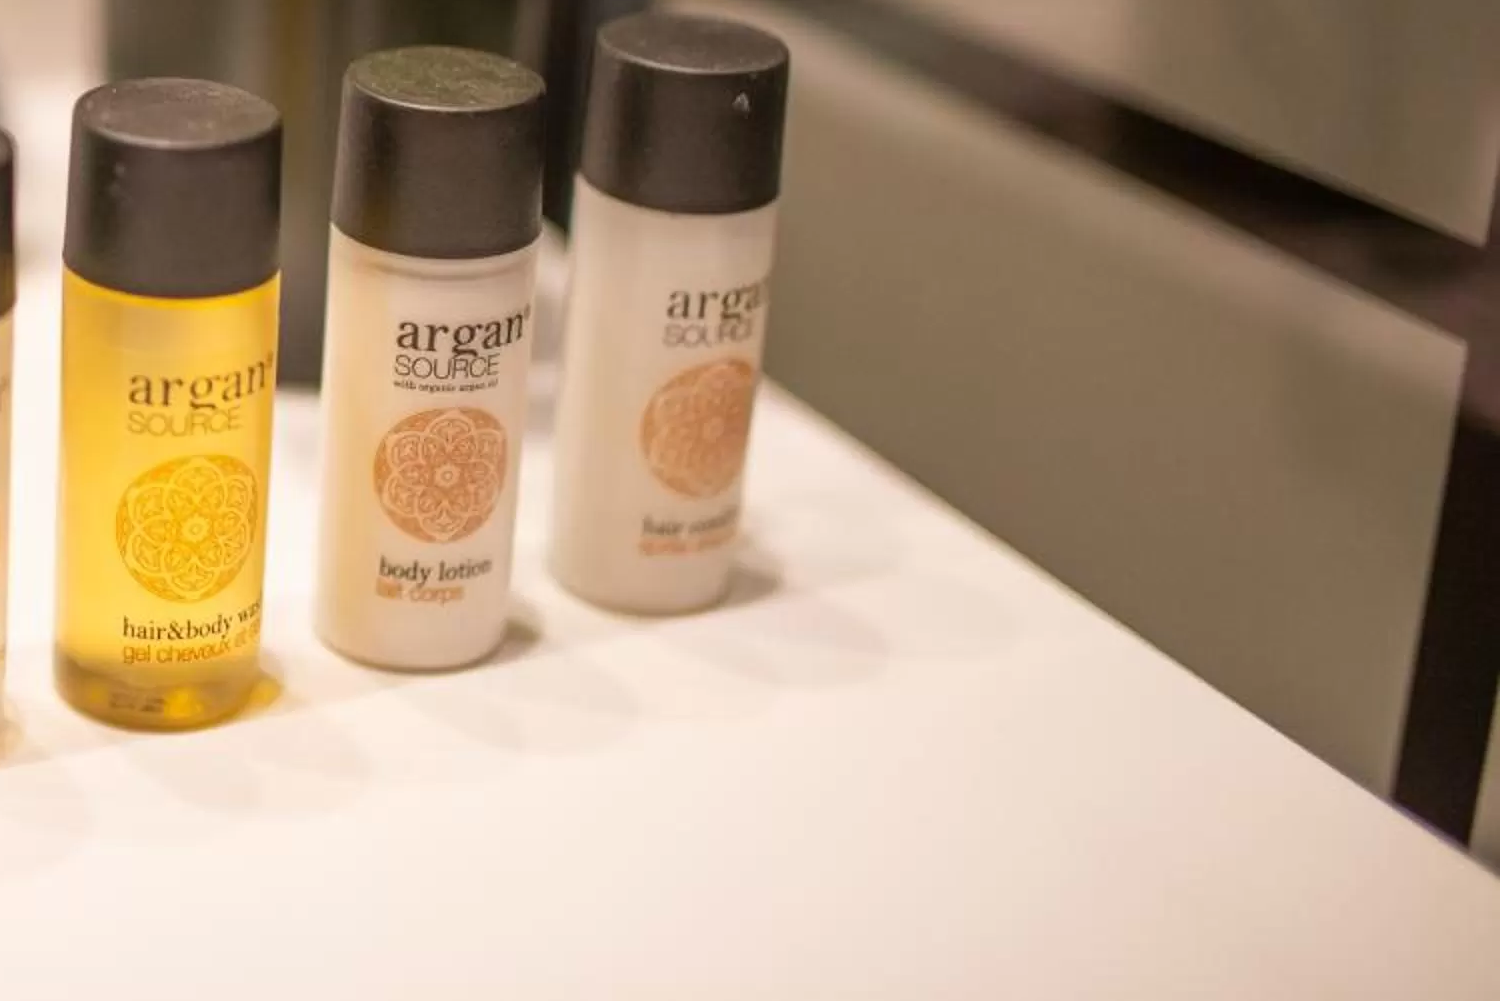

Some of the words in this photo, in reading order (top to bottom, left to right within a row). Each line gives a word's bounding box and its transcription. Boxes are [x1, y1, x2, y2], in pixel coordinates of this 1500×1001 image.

[393, 352, 500, 380] SOURCE
[393, 379, 416, 391] with
[418, 382, 456, 393] organic
[459, 381, 485, 392] argan
[128, 404, 243, 437] SOURCE
[379, 555, 431, 588] body
[438, 558, 493, 582] lotion
[122, 614, 233, 641] hair&body
[122, 644, 152, 664] gel
[156, 635, 231, 664] cheveux
